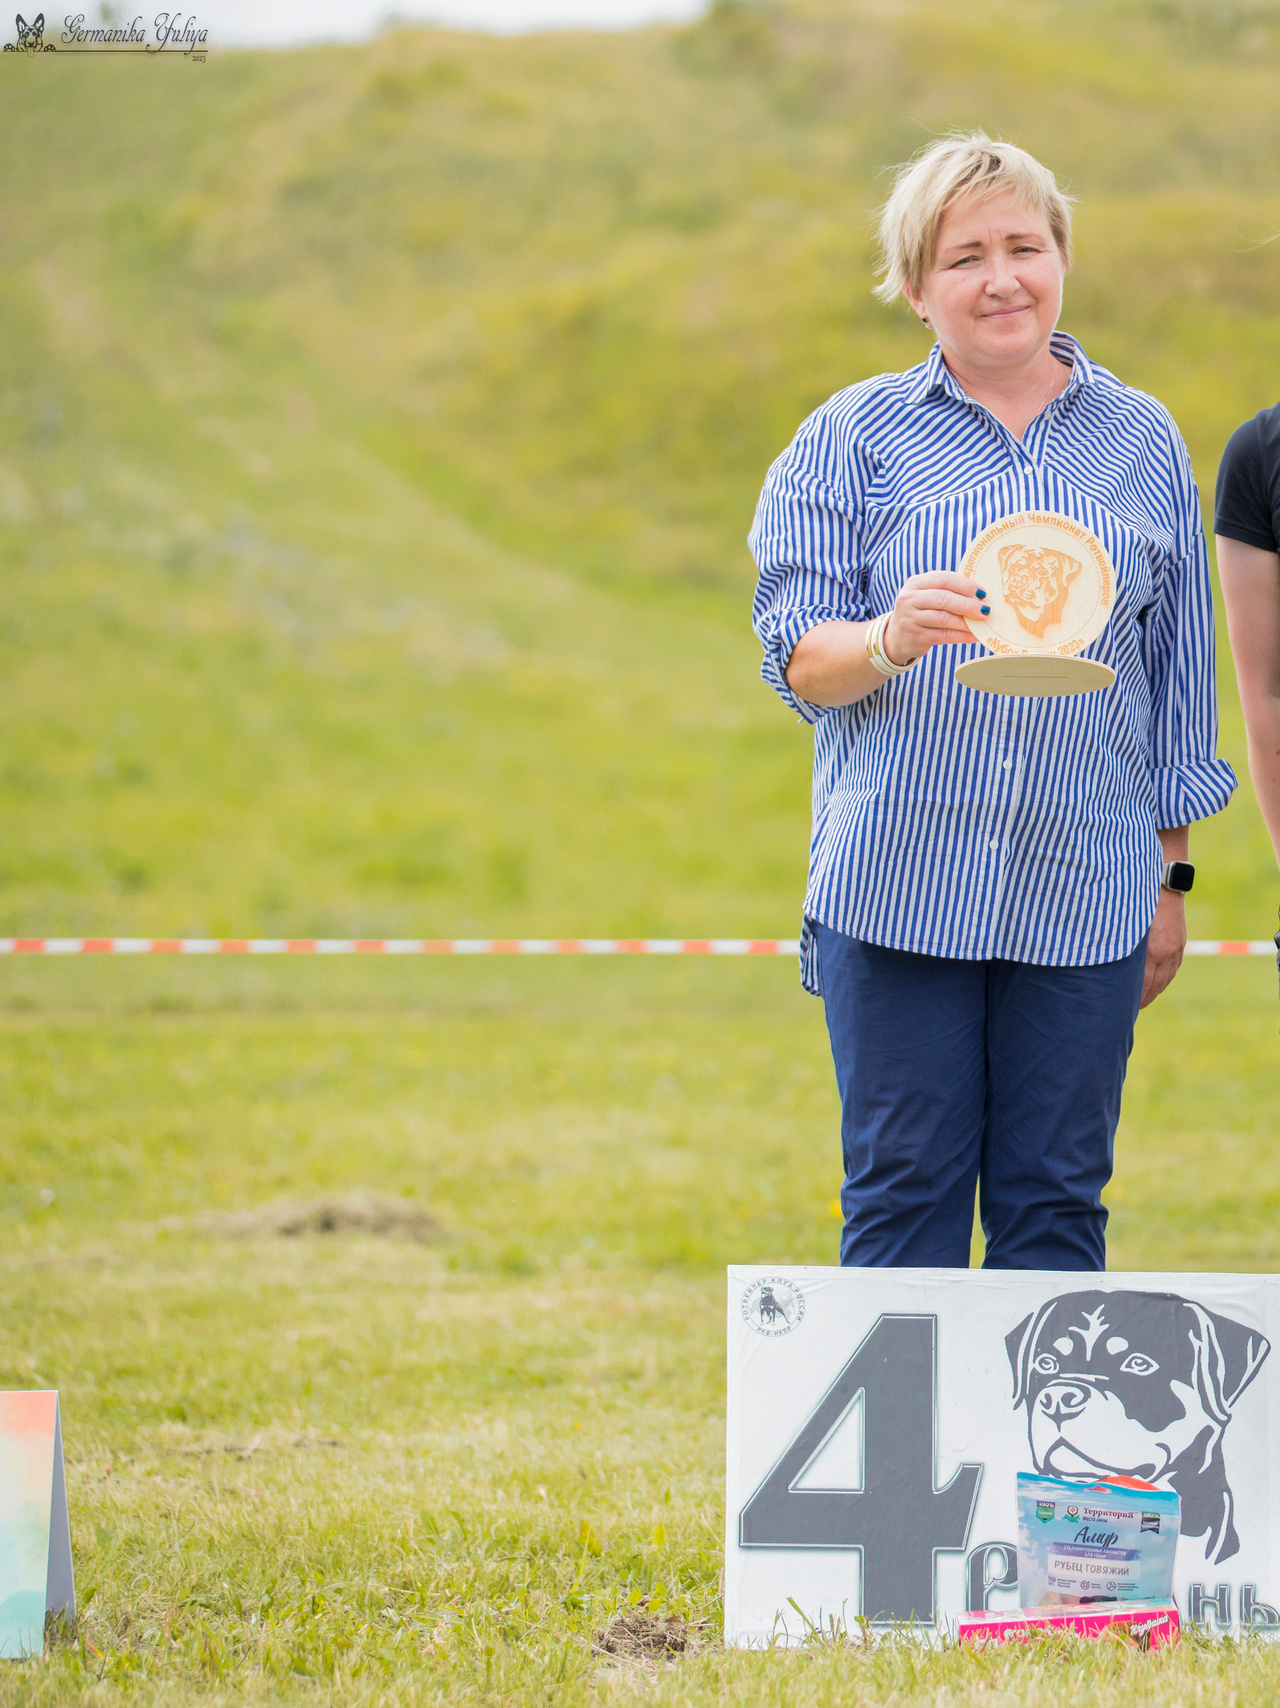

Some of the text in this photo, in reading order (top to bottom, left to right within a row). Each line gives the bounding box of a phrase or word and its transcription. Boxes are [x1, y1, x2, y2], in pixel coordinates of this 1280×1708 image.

[963, 513, 1111, 607] жрегиональный Чемпионат Ротвейлеров
[772, 1278, 793, 1287] КЛУБ
[794, 1288, 805, 1322] РОССИИ
[739, 1313, 984, 1627] 4
[1074, 1525, 1119, 1548] Амур
[1054, 1560, 1130, 1576] РУБЕЦ ГОВЯЖИЙ
